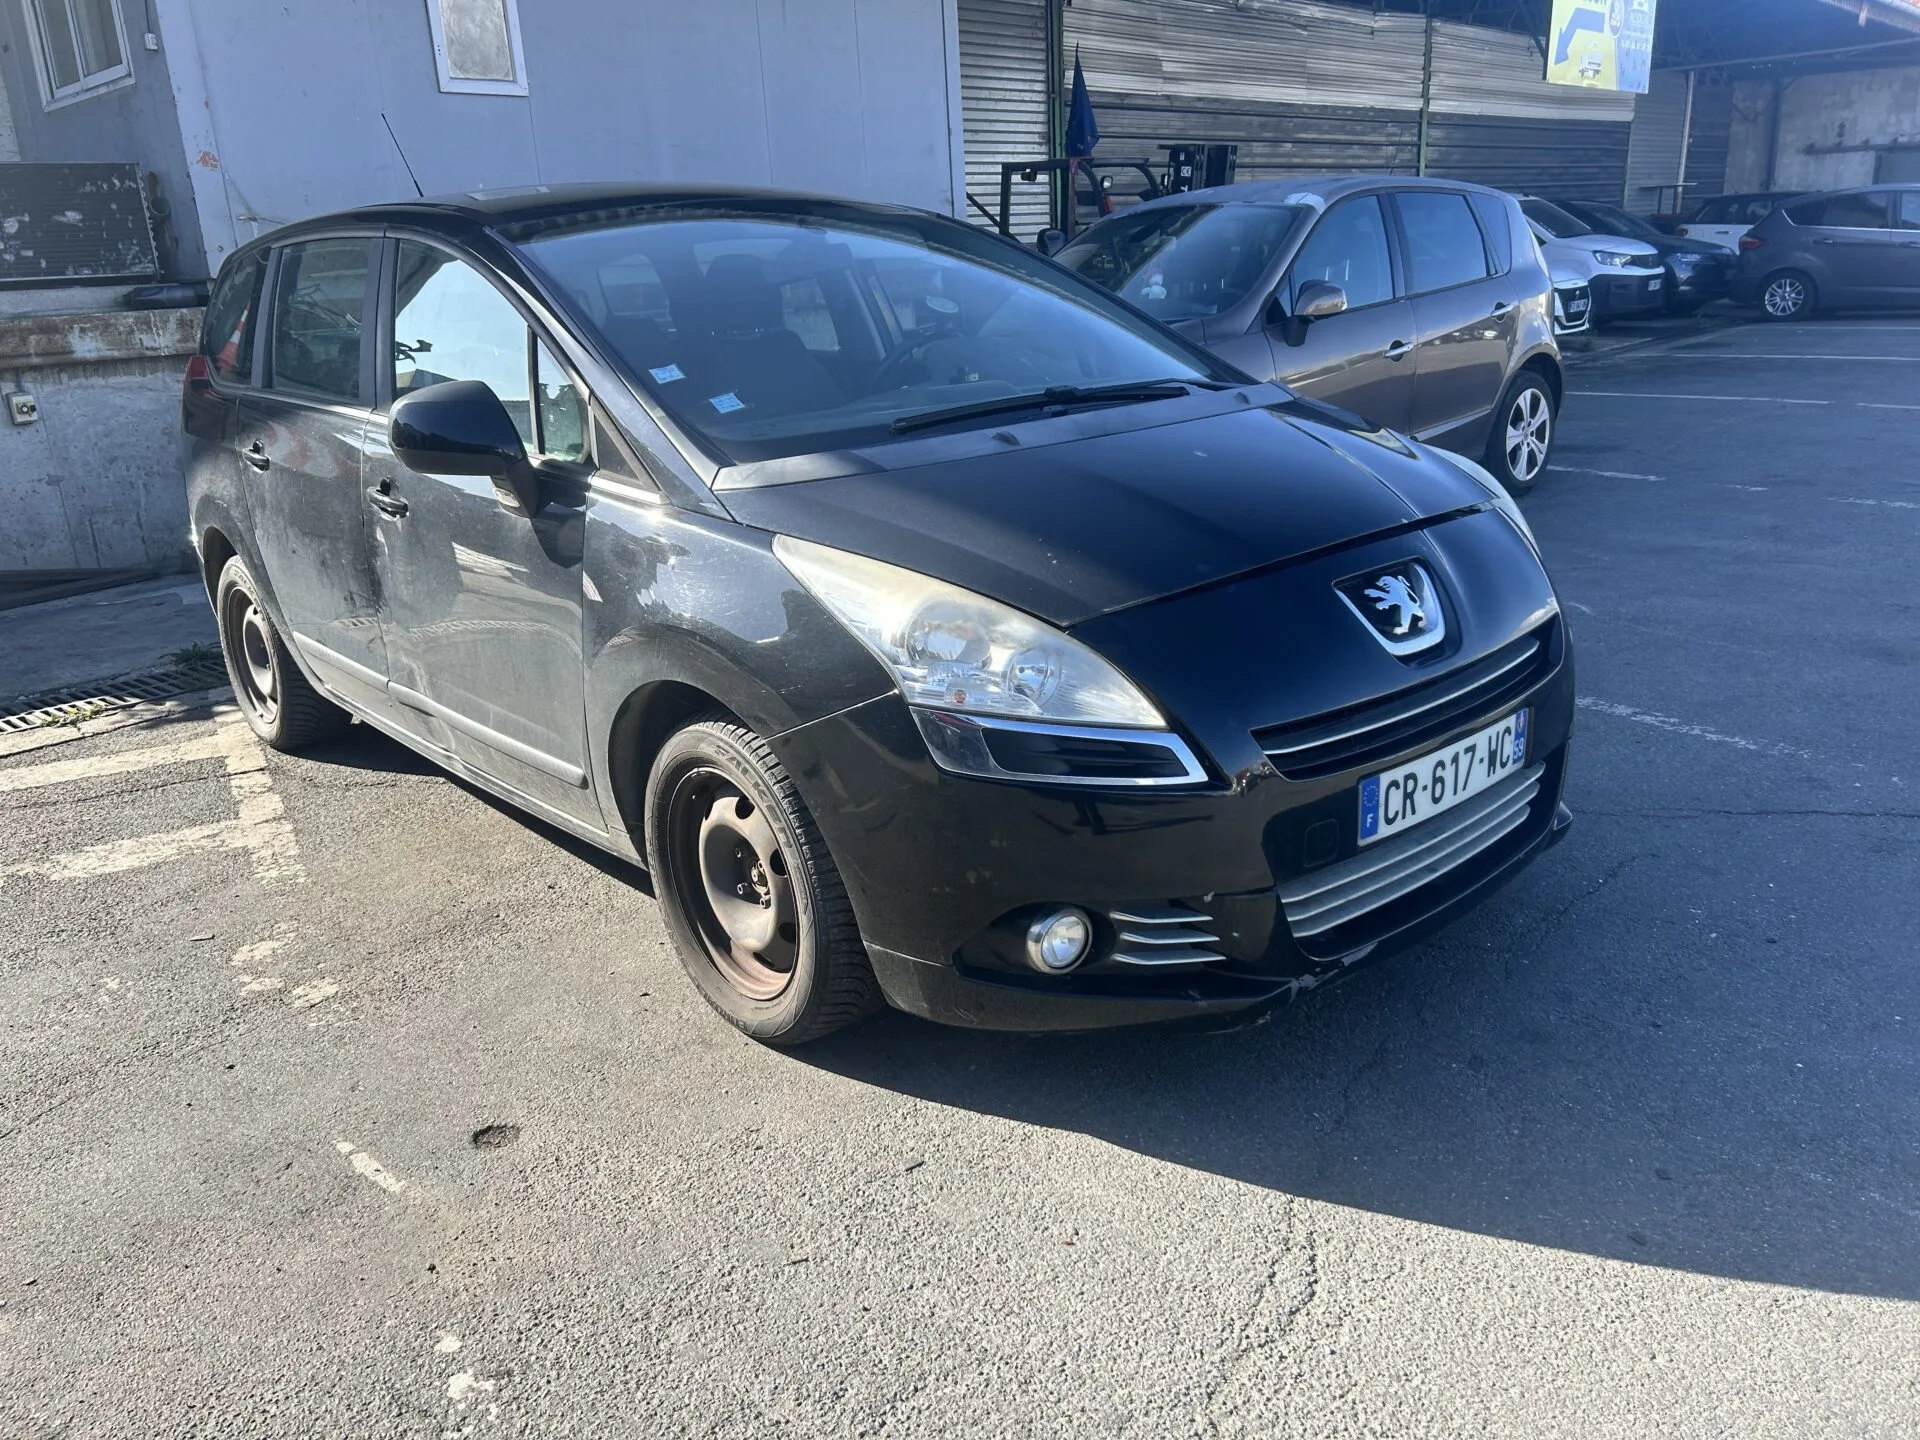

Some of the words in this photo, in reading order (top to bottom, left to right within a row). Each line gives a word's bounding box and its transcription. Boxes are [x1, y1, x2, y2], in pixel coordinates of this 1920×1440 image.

[1513, 737, 1524, 760] 59
[1384, 726, 1511, 825] CR-617-WC
[1366, 813, 1374, 828] F
